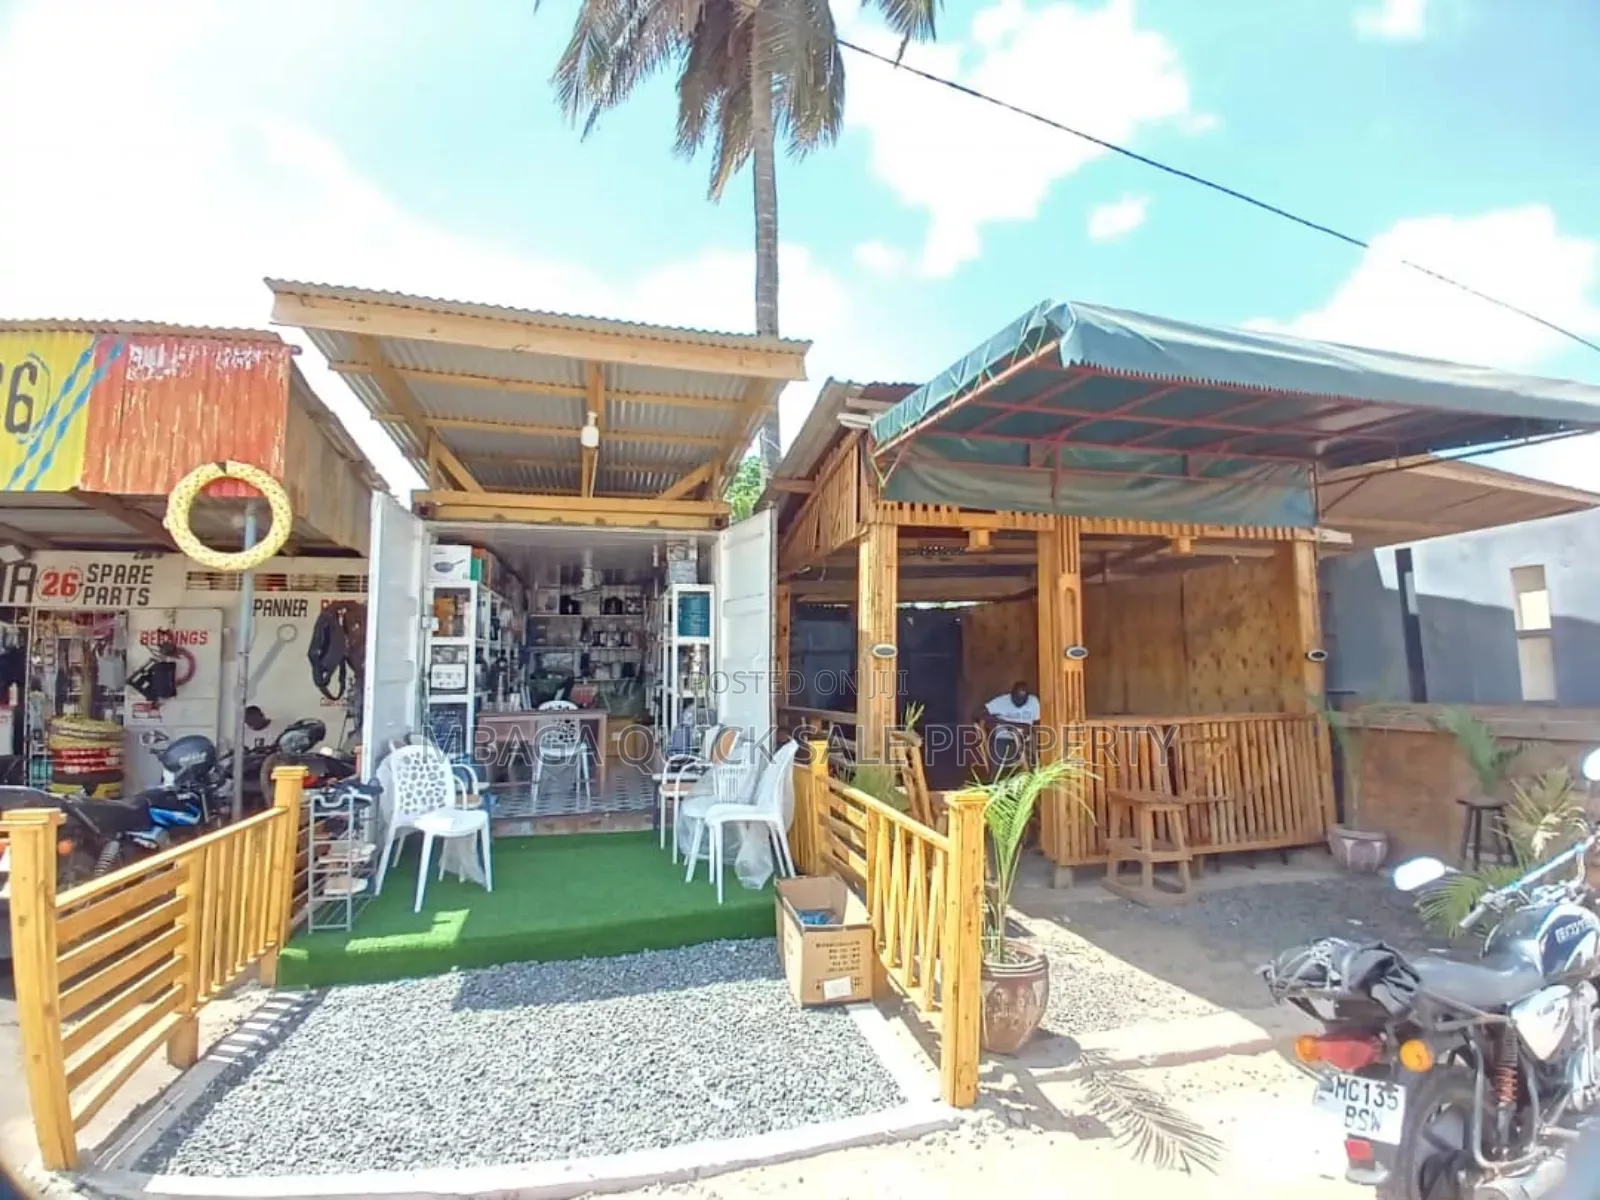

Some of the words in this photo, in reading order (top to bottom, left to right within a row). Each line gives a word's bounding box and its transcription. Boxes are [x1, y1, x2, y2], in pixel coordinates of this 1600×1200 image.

[0, 361, 37, 433] 6
[41, 571, 79, 597] 26
[87, 563, 154, 585] SPARE
[83, 586, 150, 606] PARTS
[1335, 1076, 1399, 1110] MC135
